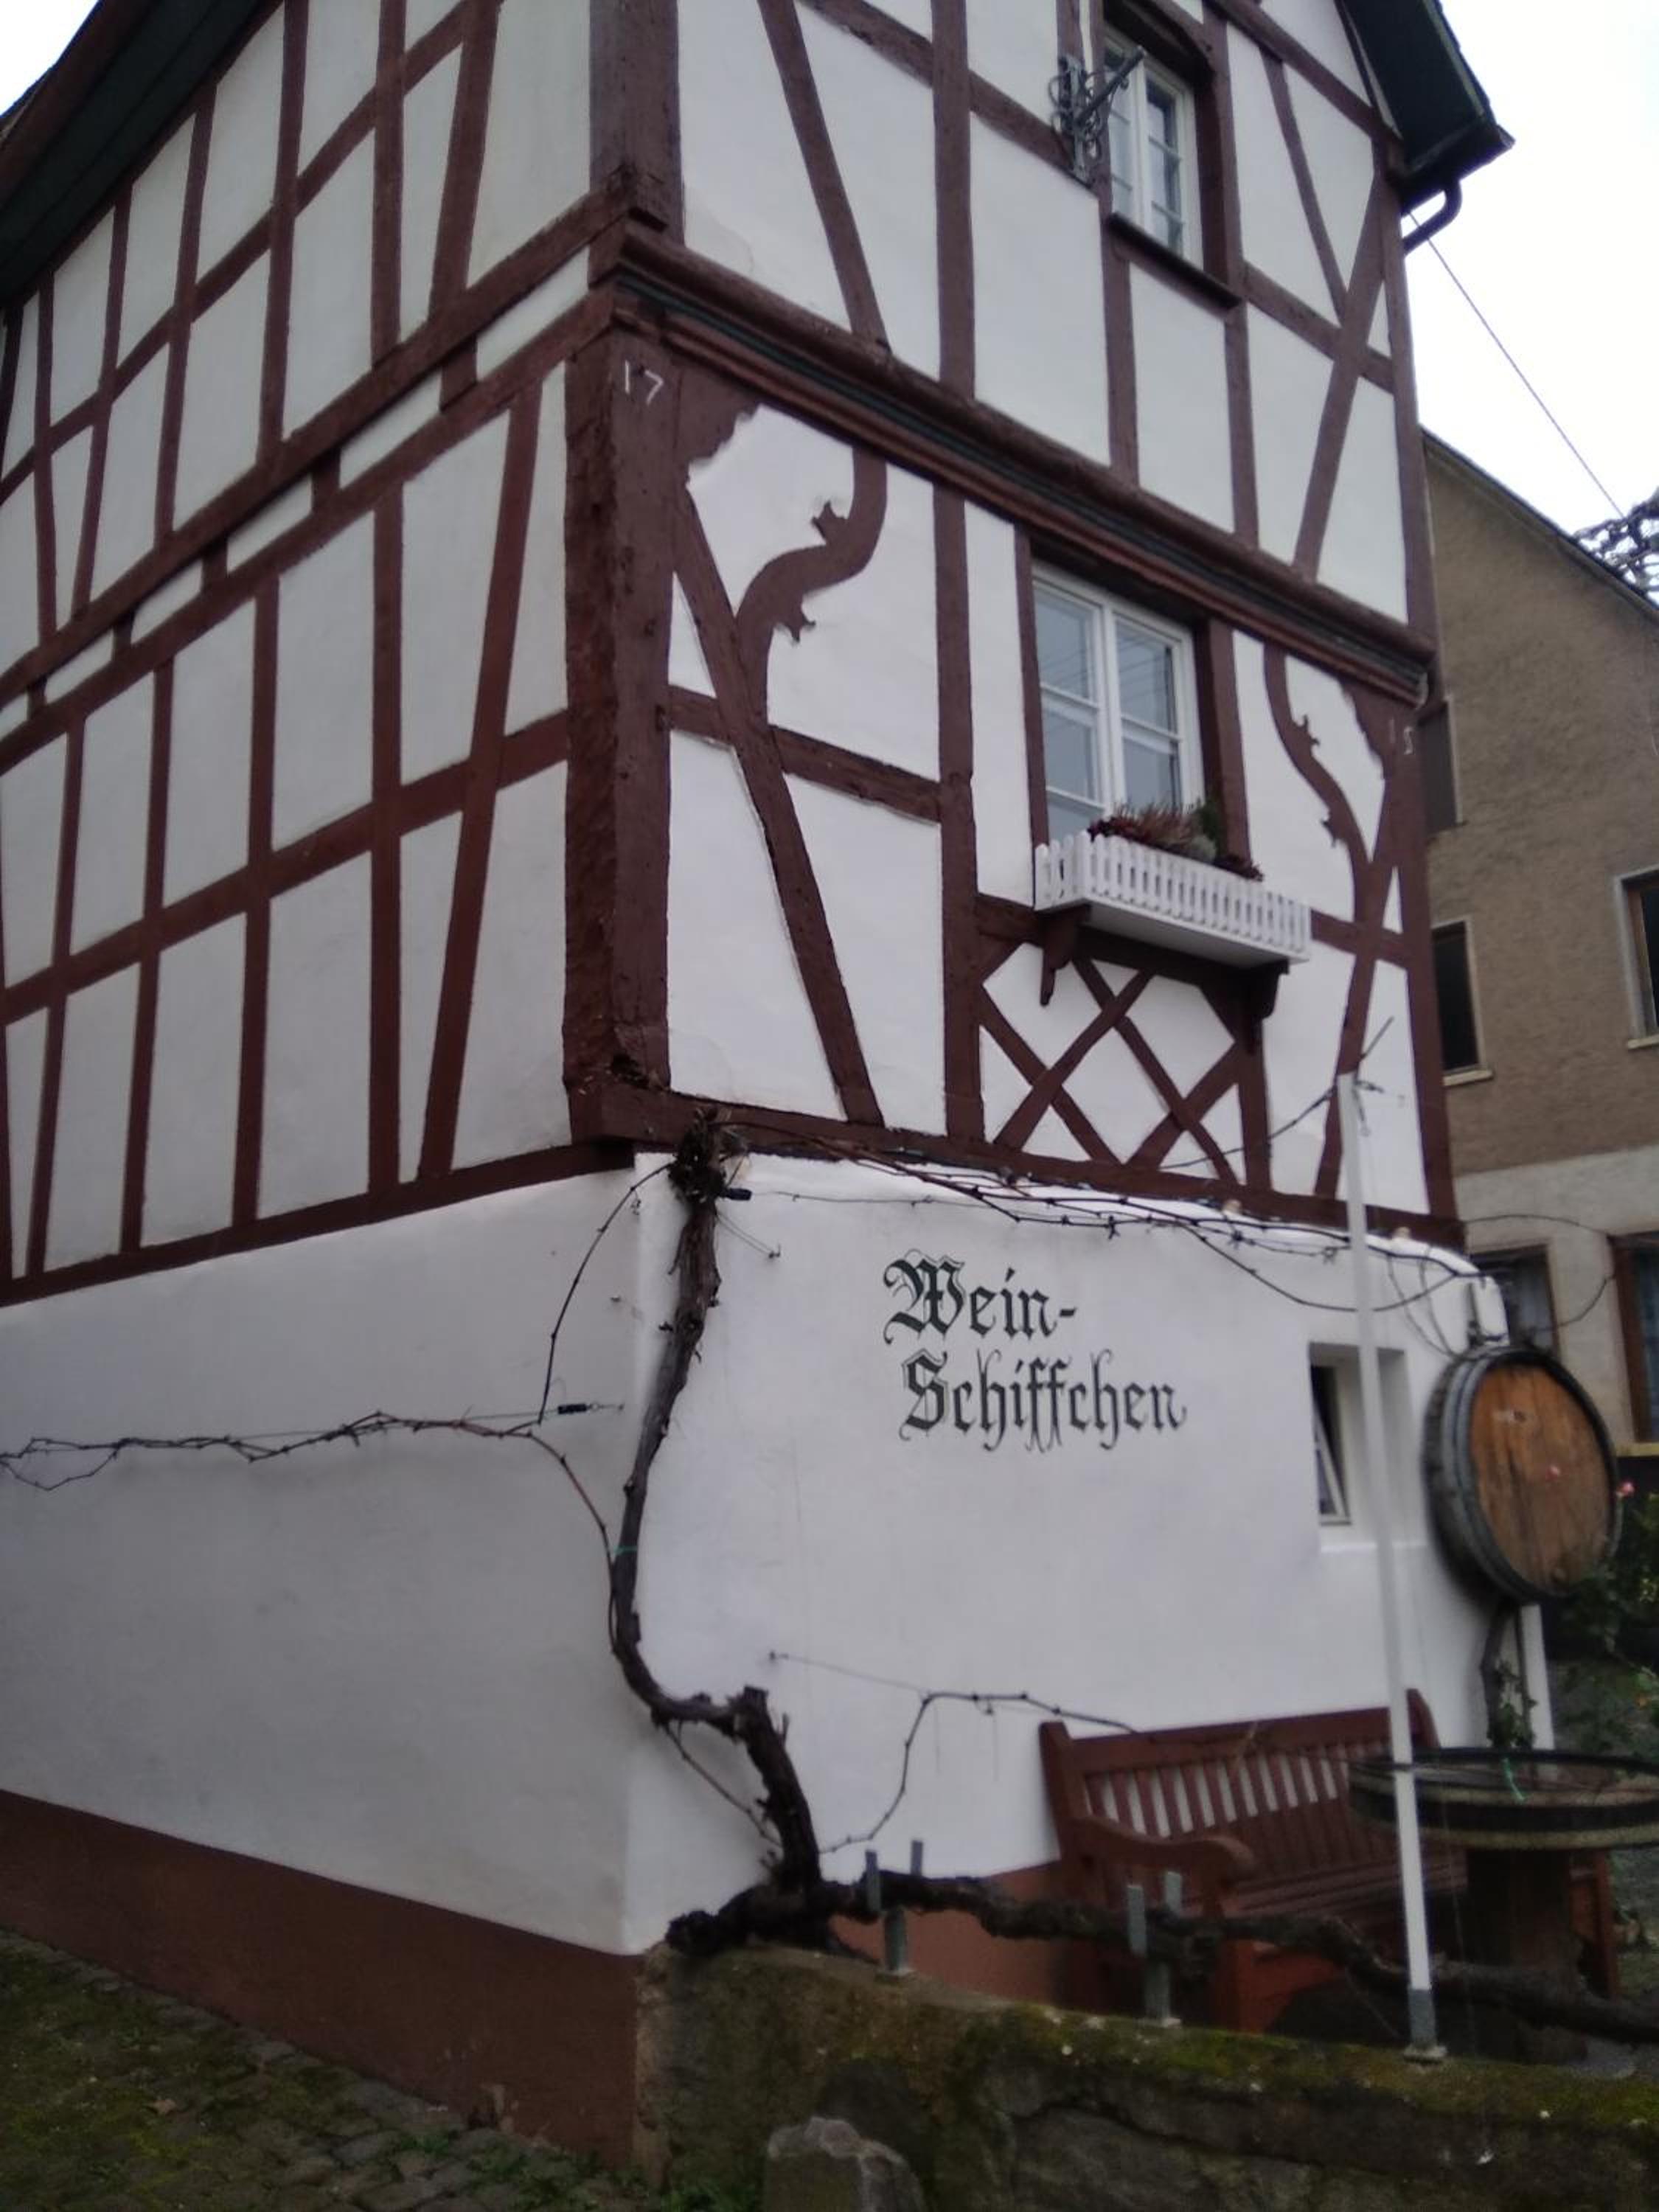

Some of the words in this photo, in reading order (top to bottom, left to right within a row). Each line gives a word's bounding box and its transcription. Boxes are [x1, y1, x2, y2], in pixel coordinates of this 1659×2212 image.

[625, 358, 664, 406] 17
[883, 1249, 1077, 1344] Wein-
[899, 1349, 1187, 1453] Schiffchen
